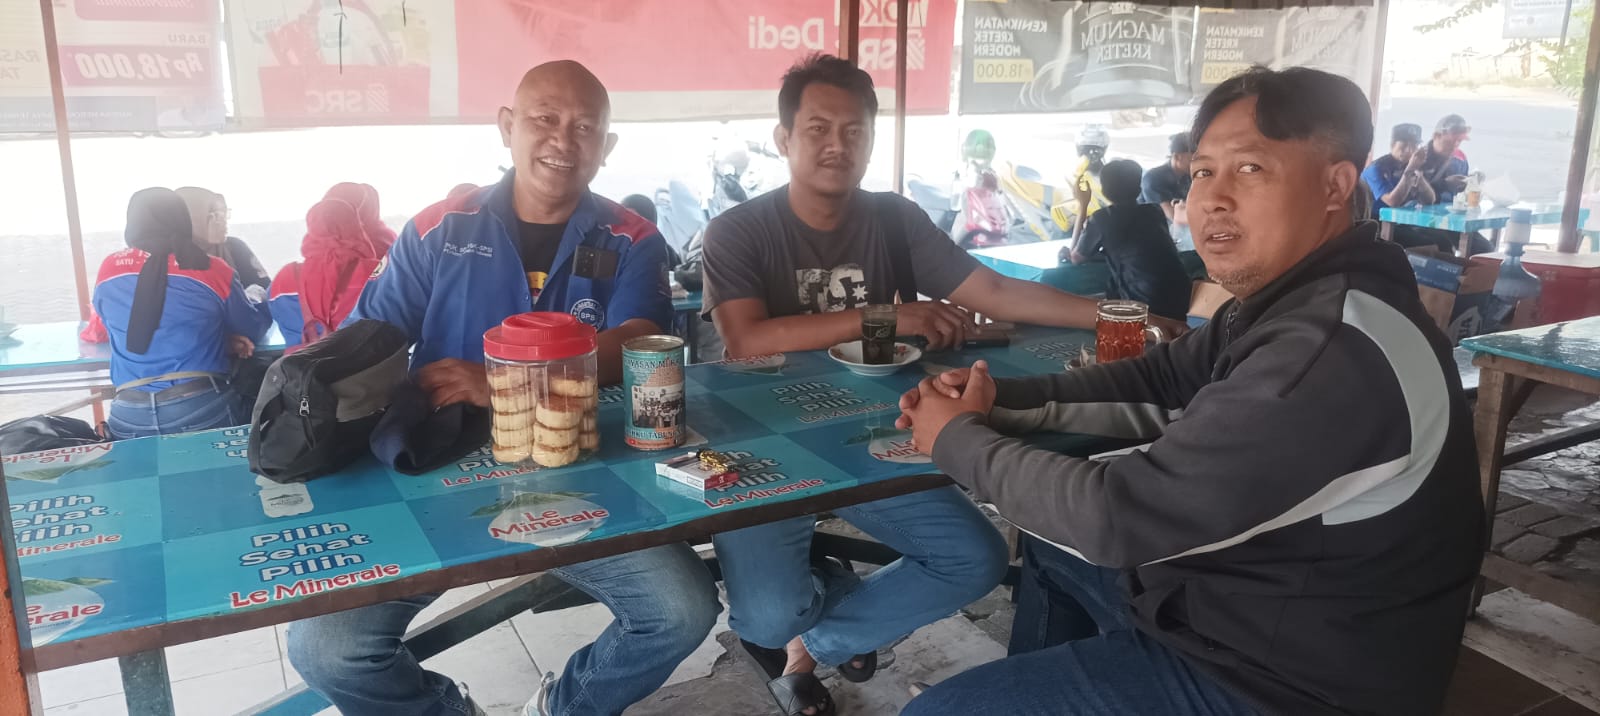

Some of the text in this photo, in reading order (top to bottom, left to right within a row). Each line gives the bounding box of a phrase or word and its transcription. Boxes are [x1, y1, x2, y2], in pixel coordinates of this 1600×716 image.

[771, 380, 833, 395] Pilih
[776, 387, 856, 405] Sehat
[800, 397, 865, 413] Pilih
[39, 454, 72, 464] Le
[441, 476, 471, 487] Le
[704, 478, 825, 509] Le Minerale
[12, 505, 109, 529] ehat
[490, 508, 610, 538] Minerale
[525, 508, 561, 522] Le
[15, 523, 92, 544] ilih
[252, 522, 350, 548] Pilih
[240, 533, 372, 567] Sehat
[260, 552, 364, 582] Pilih
[230, 563, 401, 609] Le Minerale
